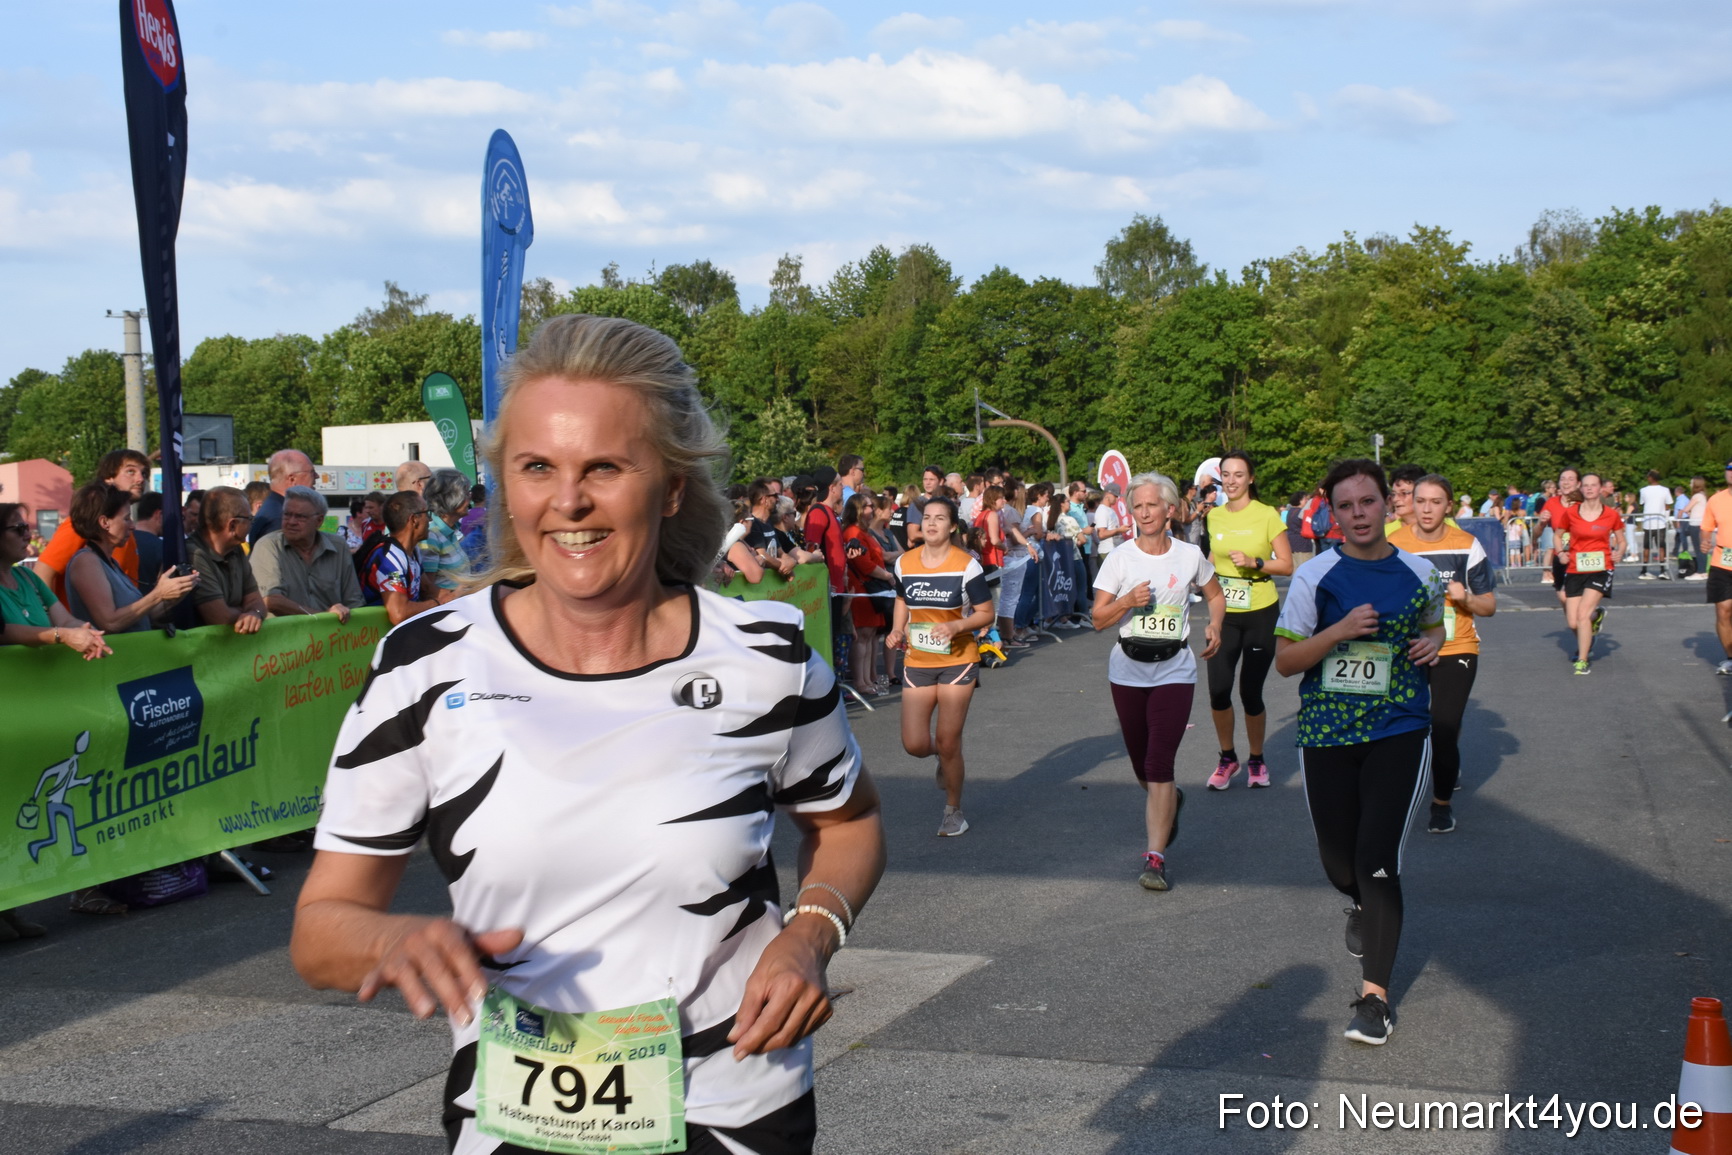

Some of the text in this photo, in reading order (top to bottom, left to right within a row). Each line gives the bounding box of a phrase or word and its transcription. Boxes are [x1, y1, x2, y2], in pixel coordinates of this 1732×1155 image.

[1580, 558, 1601, 567] 1033
[912, 589, 953, 598] Fischer
[1139, 615, 1176, 631] 1316
[254, 626, 380, 682] Gesunde Firmen
[1335, 659, 1376, 680] 270
[285, 663, 372, 709] laufen län
[142, 696, 191, 721] Fischer
[148, 710, 190, 729] AUTOMOBILE
[89, 716, 261, 823] firmenlauf
[96, 799, 175, 845] neumarkt
[628, 1042, 667, 1061] 2019
[514, 1055, 633, 1115] 794
[498, 1102, 656, 1134] Haberstumpf Karola
